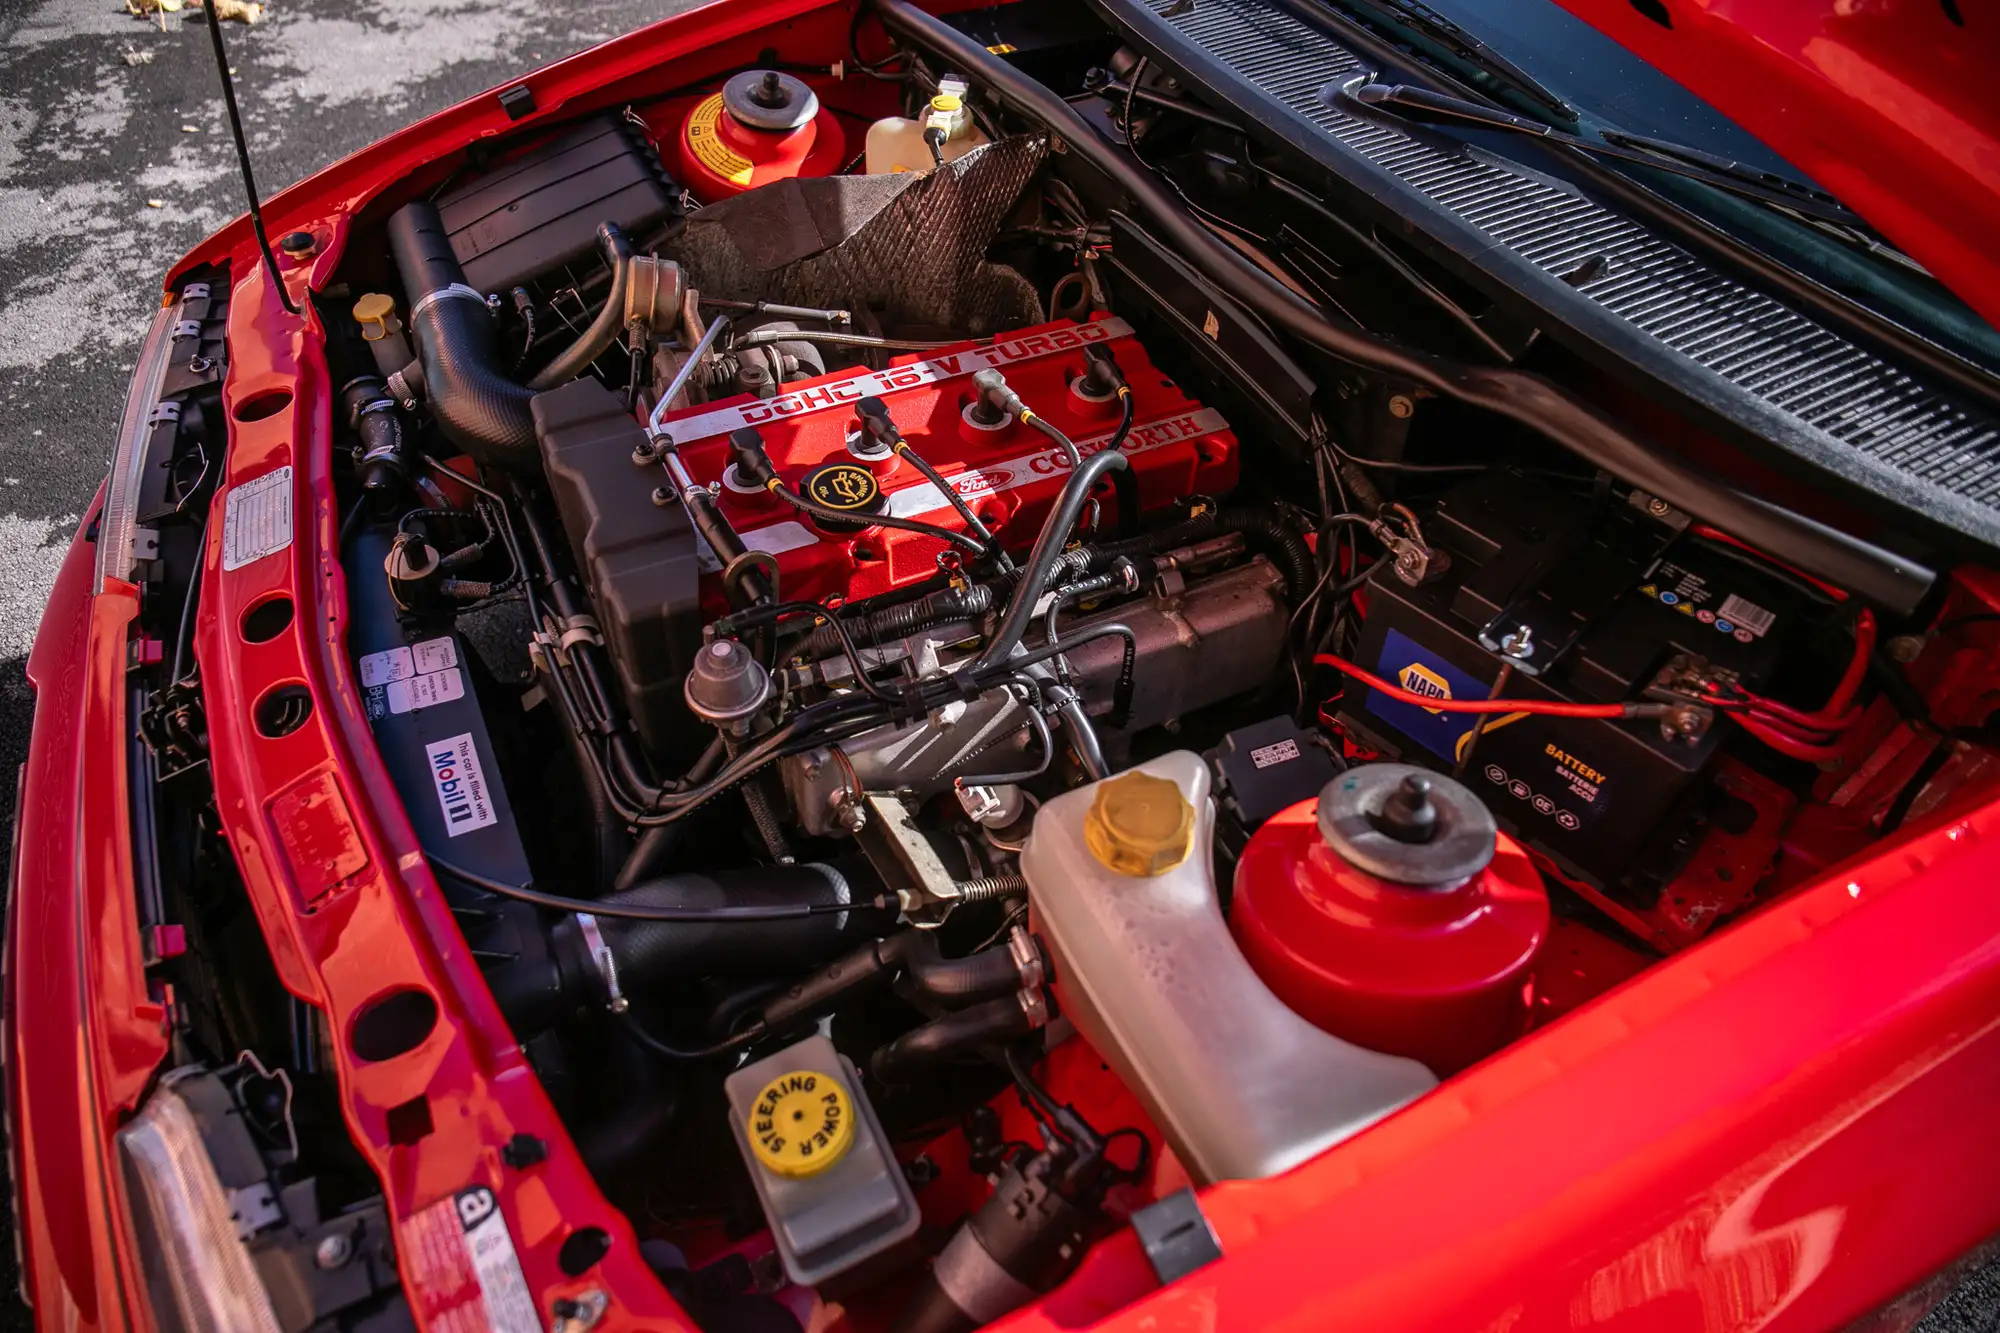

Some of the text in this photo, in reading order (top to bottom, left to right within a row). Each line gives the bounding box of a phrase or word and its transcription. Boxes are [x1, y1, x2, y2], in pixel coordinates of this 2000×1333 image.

[739, 381, 863, 424] DOHC
[974, 323, 1109, 365] TURBO
[818, 485, 830, 498] OIL
[848, 472, 869, 498] ENGINE
[960, 473, 1001, 493] Ford
[369, 685, 384, 701] BH
[1405, 670, 1446, 699] NAPA
[433, 750, 466, 804] Mobil
[1544, 743, 1606, 785] BATTERY
[459, 740, 489, 820] This car is filled with
[1555, 765, 1599, 795] BATTERIE
[1568, 783, 1595, 803] ACCU
[756, 1076, 841, 1156] STEERING POWER
